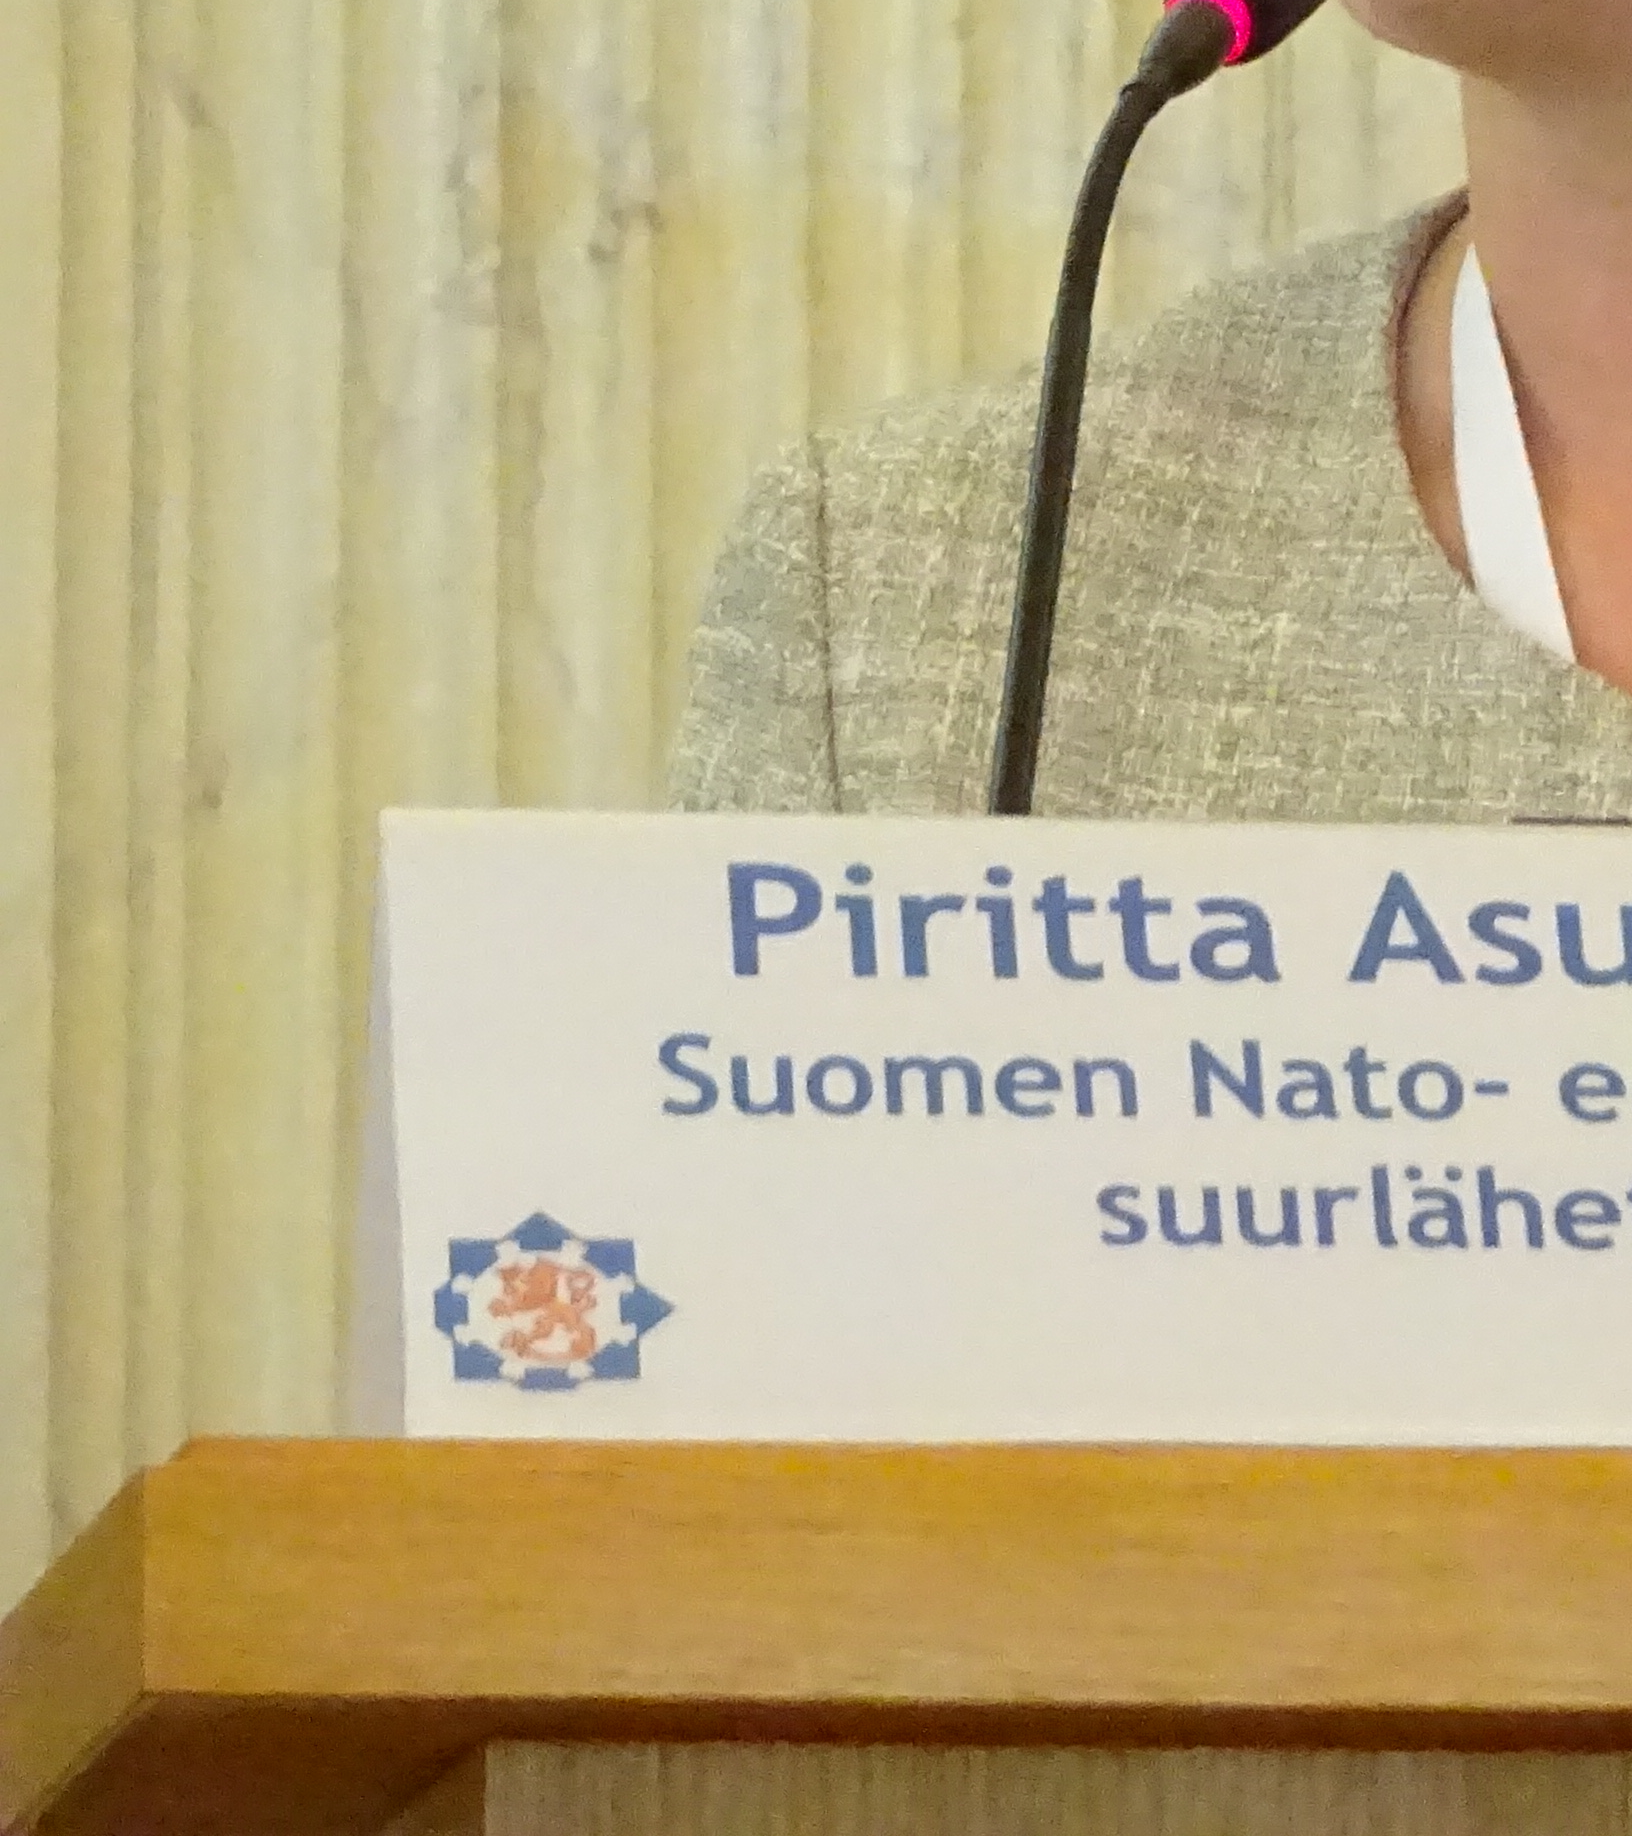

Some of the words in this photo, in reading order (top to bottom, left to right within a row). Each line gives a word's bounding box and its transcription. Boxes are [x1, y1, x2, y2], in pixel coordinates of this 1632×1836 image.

[727, 860, 1280, 983] Piritta
[657, 1031, 1138, 1117] Suomen
[1190, 1037, 1510, 1121] Nato-
